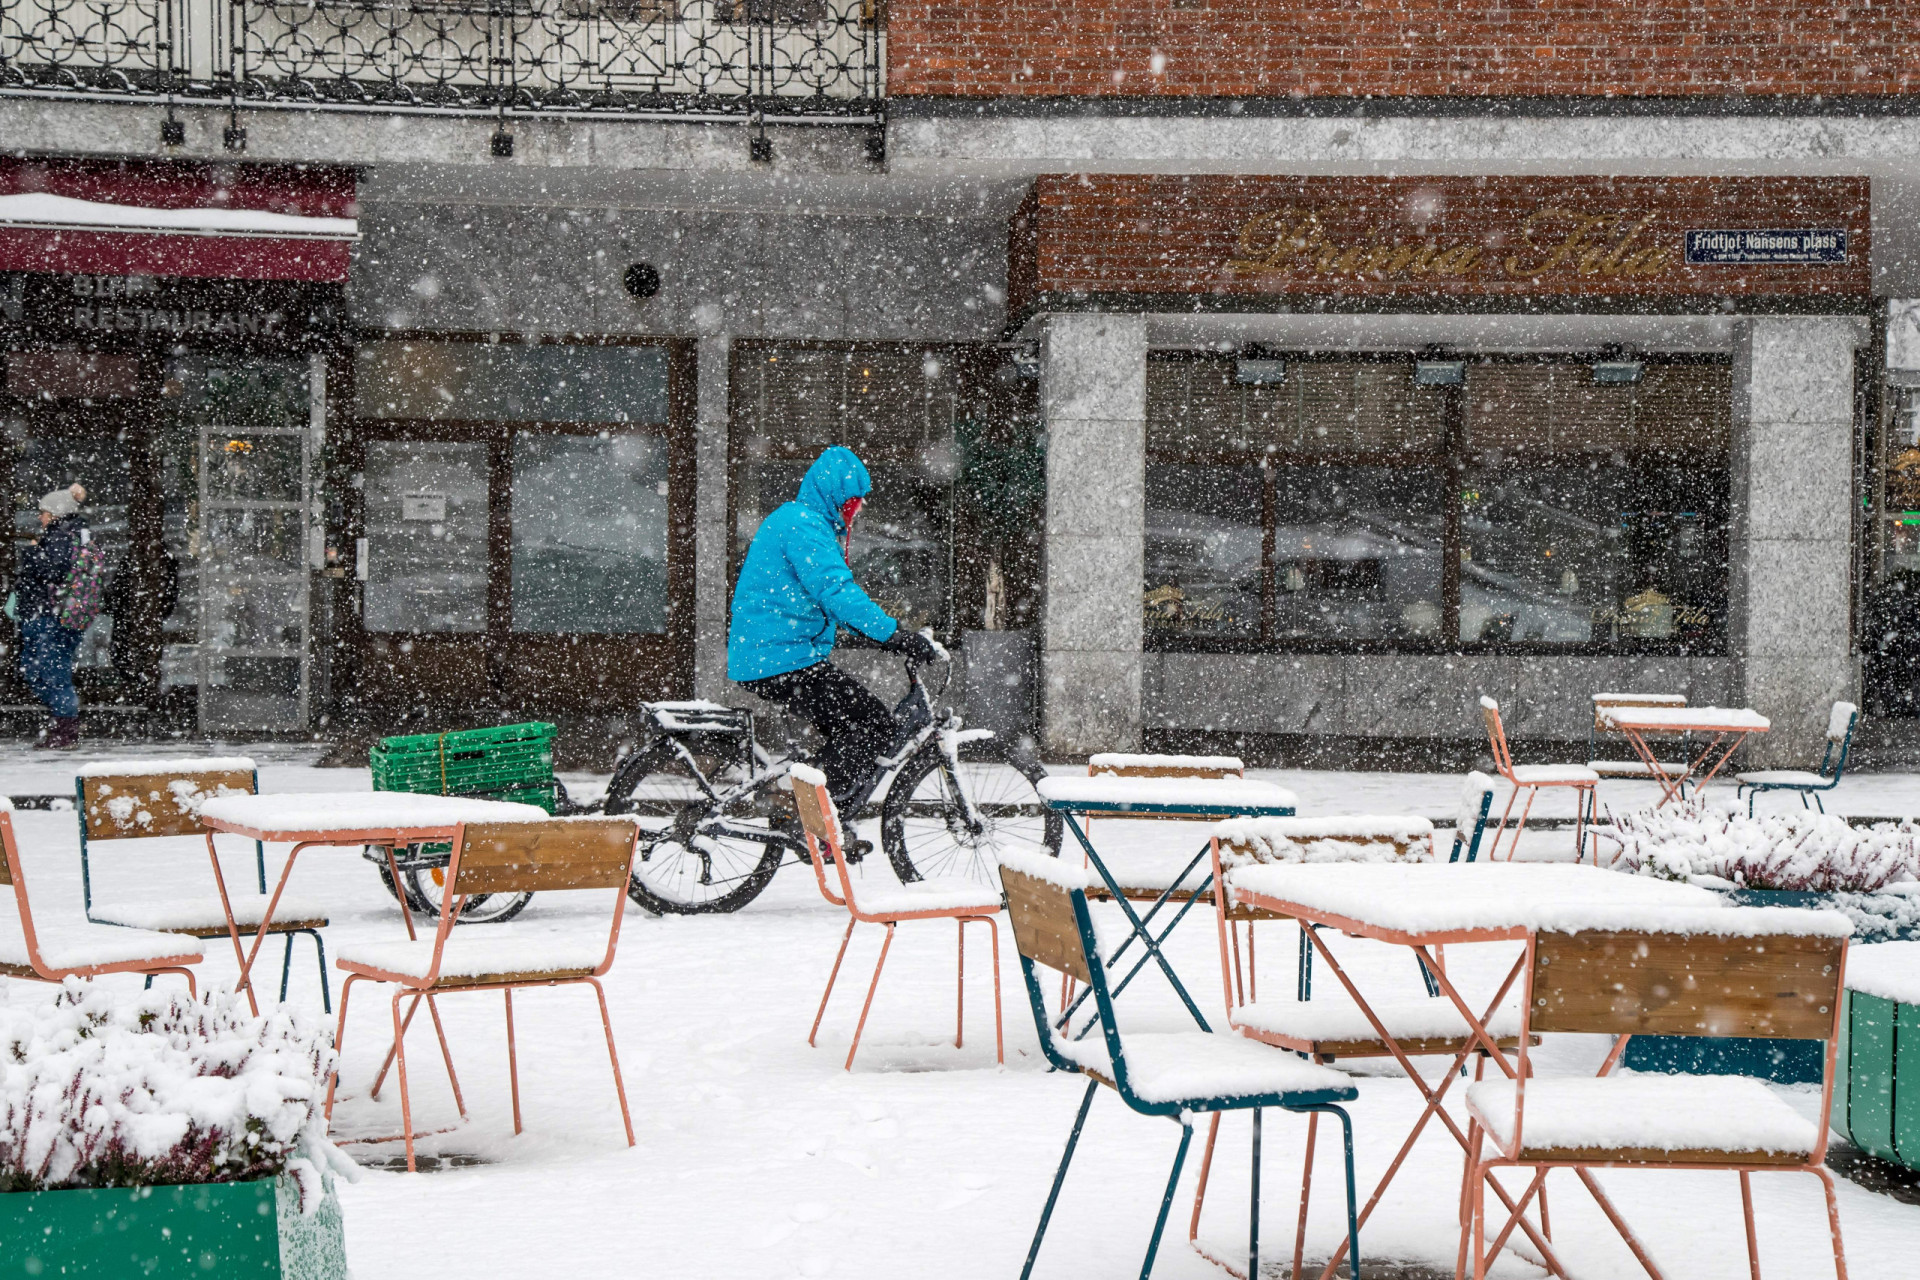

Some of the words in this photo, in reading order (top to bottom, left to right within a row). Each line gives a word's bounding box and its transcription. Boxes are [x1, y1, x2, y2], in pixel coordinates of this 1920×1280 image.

[1225, 205, 1482, 276] Prima
[1504, 206, 1676, 277] Fila
[1694, 233, 1741, 252] Fridtjof
[1746, 233, 1798, 250] Nansens
[1803, 232, 1837, 252] plass
[74, 306, 280, 336] RESTAURANT
